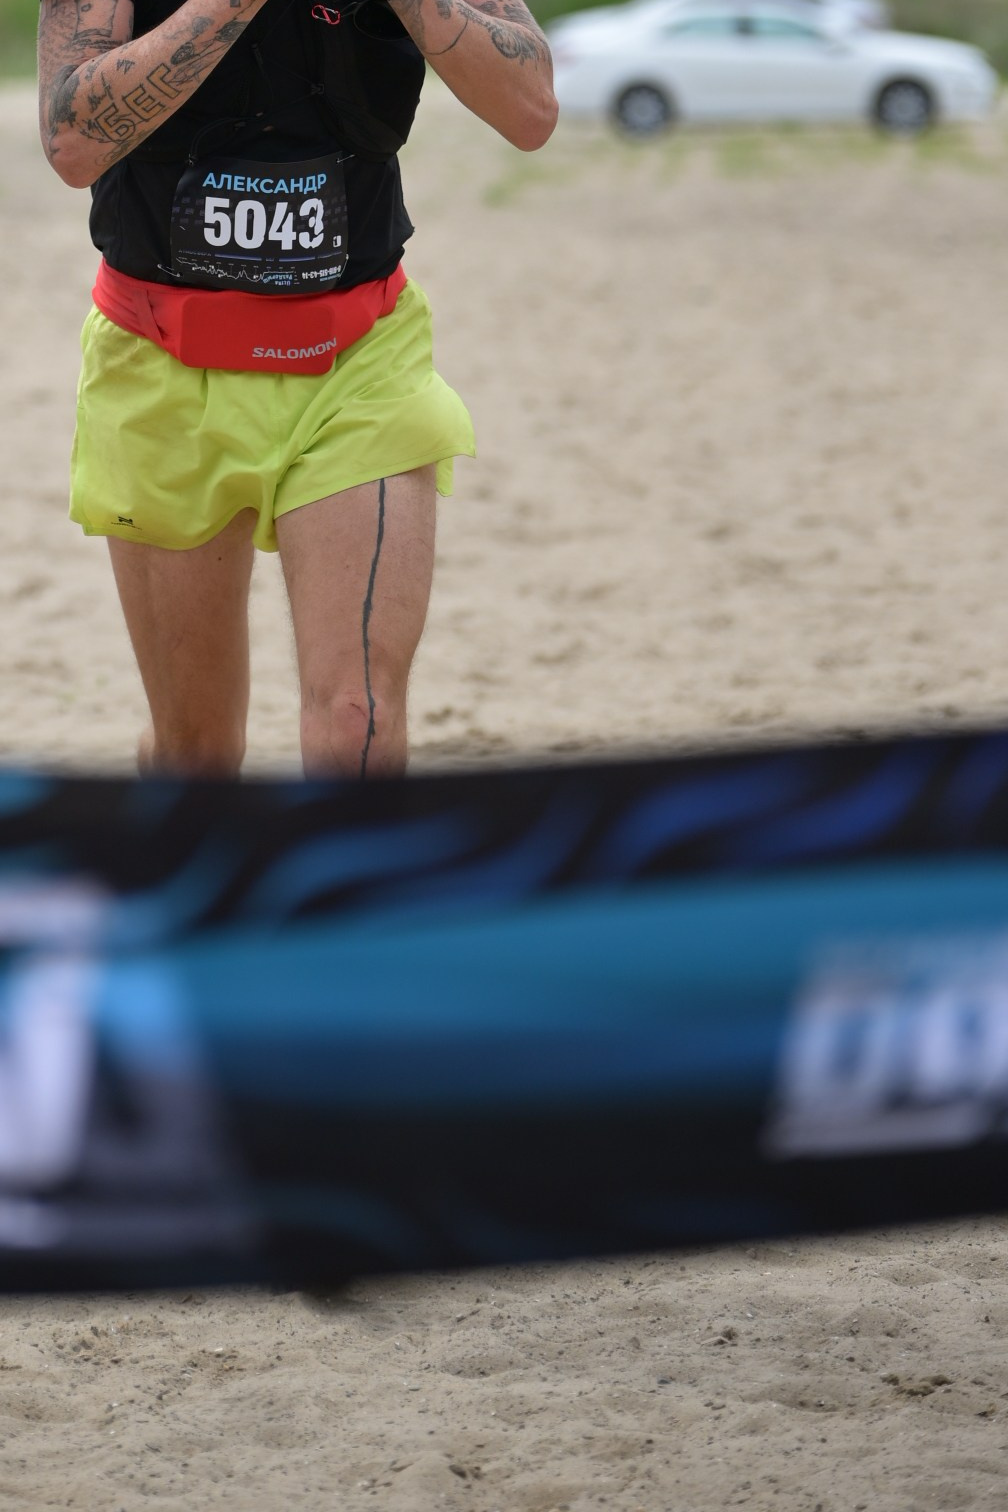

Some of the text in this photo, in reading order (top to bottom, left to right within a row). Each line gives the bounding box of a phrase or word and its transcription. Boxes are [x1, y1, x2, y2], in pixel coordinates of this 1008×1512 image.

[94, 62, 182, 144] БЕГ
[202, 172, 327, 195] АЛЕКСАНДР
[203, 196, 325, 250] 5043
[252, 336, 337, 359] SALOMON
